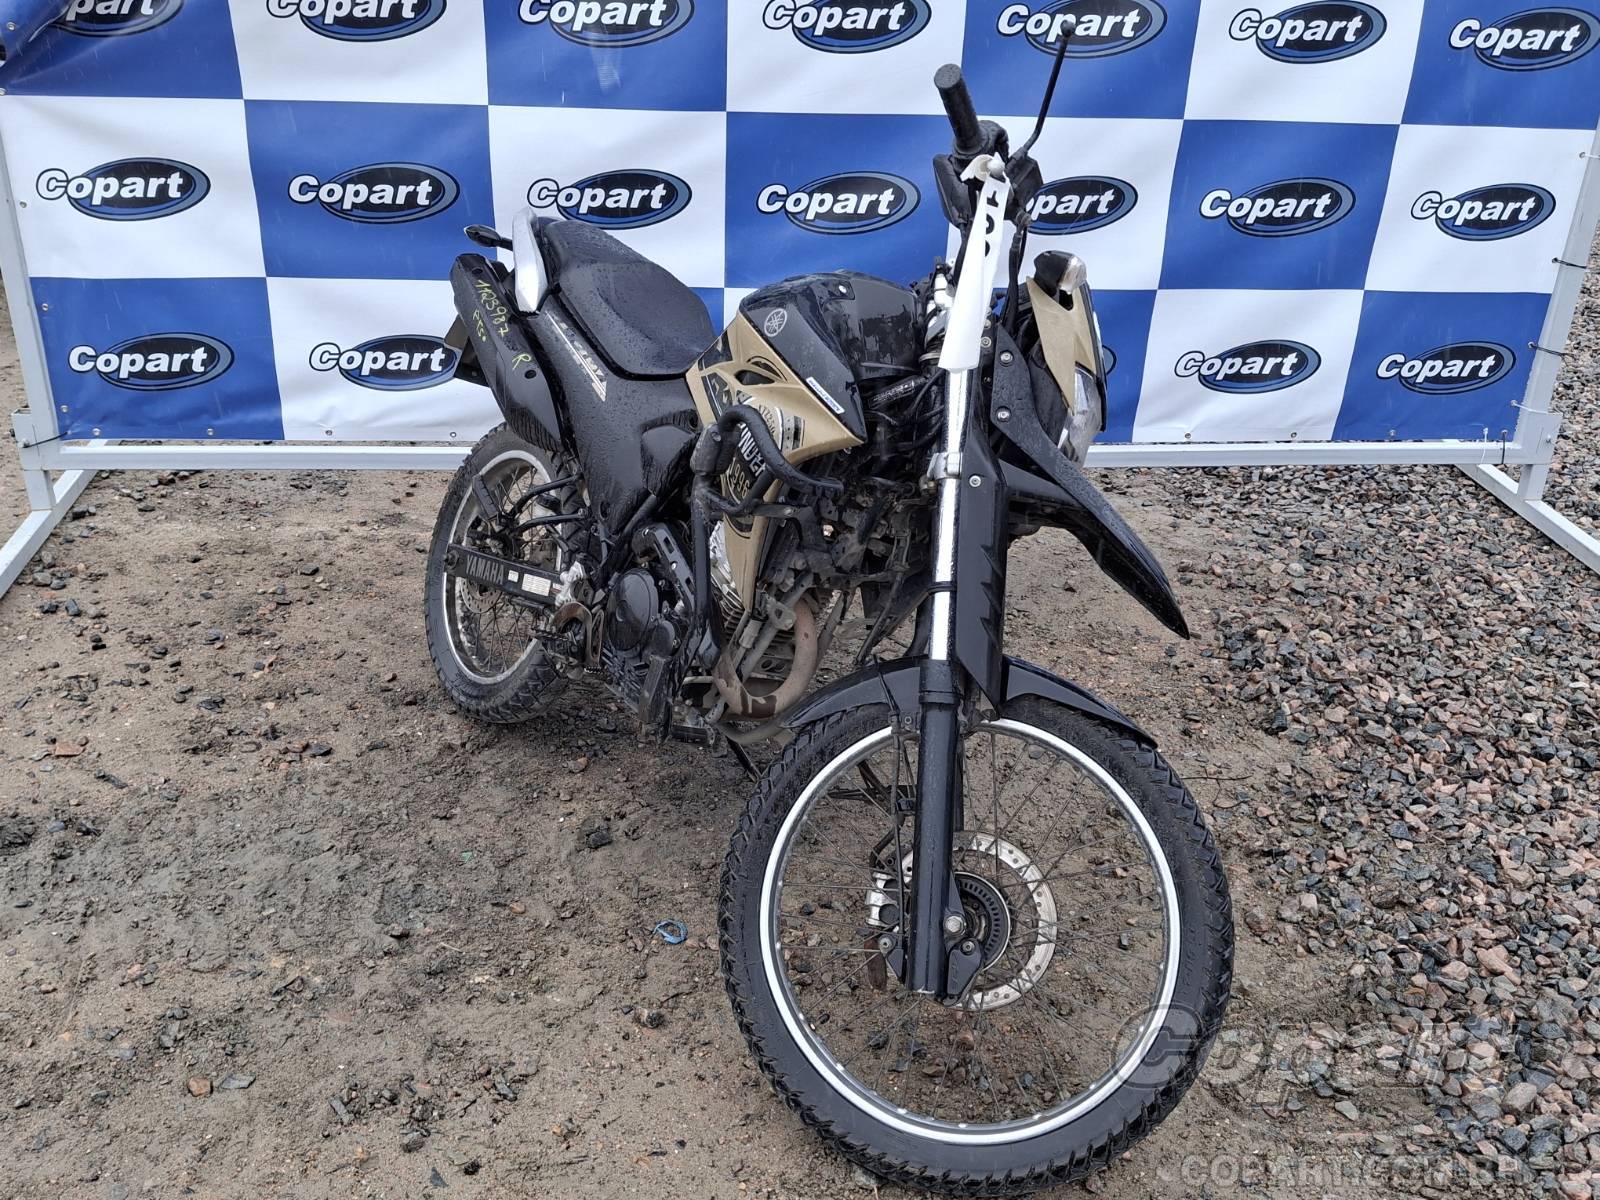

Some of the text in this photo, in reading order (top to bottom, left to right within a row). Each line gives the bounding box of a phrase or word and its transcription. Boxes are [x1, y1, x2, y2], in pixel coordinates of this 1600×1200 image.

[64, 0, 154, 21] part
[267, 0, 417, 24] Copart
[518, 0, 667, 31] Copart
[763, 0, 905, 36] Copart
[998, 4, 1140, 43] Copart
[1230, 10, 1363, 47] Copart
[1450, 19, 1581, 56] Copart
[37, 170, 184, 205] Copart
[289, 175, 433, 210] Copart
[528, 180, 667, 214] Copart
[758, 184, 895, 220] Copart
[1026, 189, 1115, 221] part
[1200, 189, 1332, 224] Copart
[1412, 192, 1536, 226] Copart
[69, 345, 208, 379] Copart
[310, 344, 446, 376] Copart
[1176, 352, 1298, 380] Copart
[1377, 354, 1496, 383] Copart
[465, 554, 505, 586] YAMAHA
